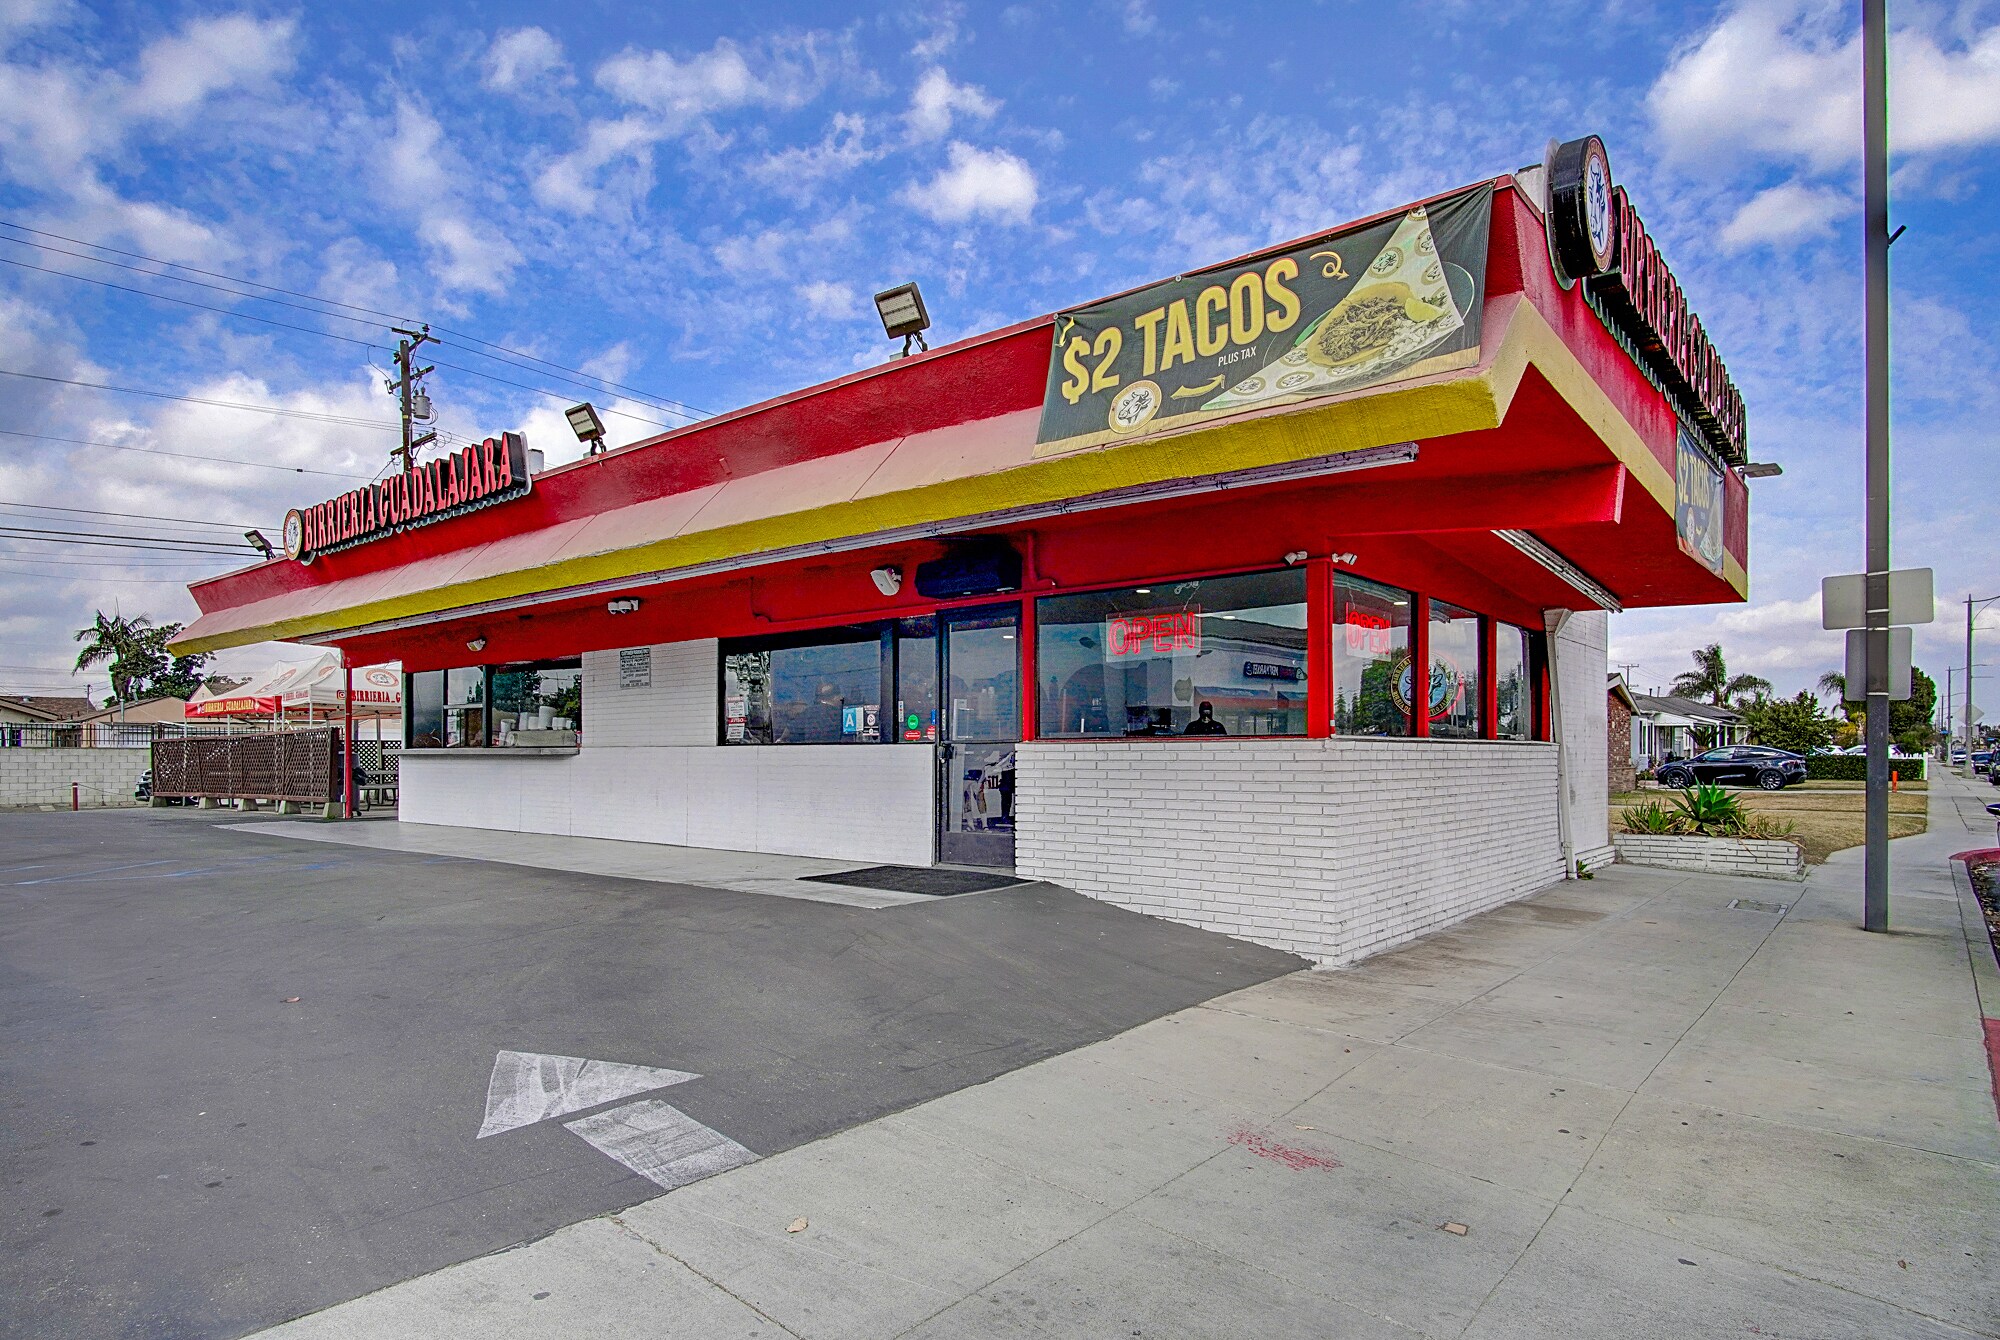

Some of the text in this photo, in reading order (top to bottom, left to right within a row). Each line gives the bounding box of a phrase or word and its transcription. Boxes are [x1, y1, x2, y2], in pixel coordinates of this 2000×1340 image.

[1061, 257, 1302, 405] $2 TACOS
[1218, 346, 1257, 367] PLUS TAX
[304, 484, 375, 552] BIRRIERIA
[378, 431, 513, 528] GUADALAJARA
[1108, 611, 1196, 656] OPEN
[1349, 610, 1391, 655] OPEN
[845, 714, 855, 728] A
